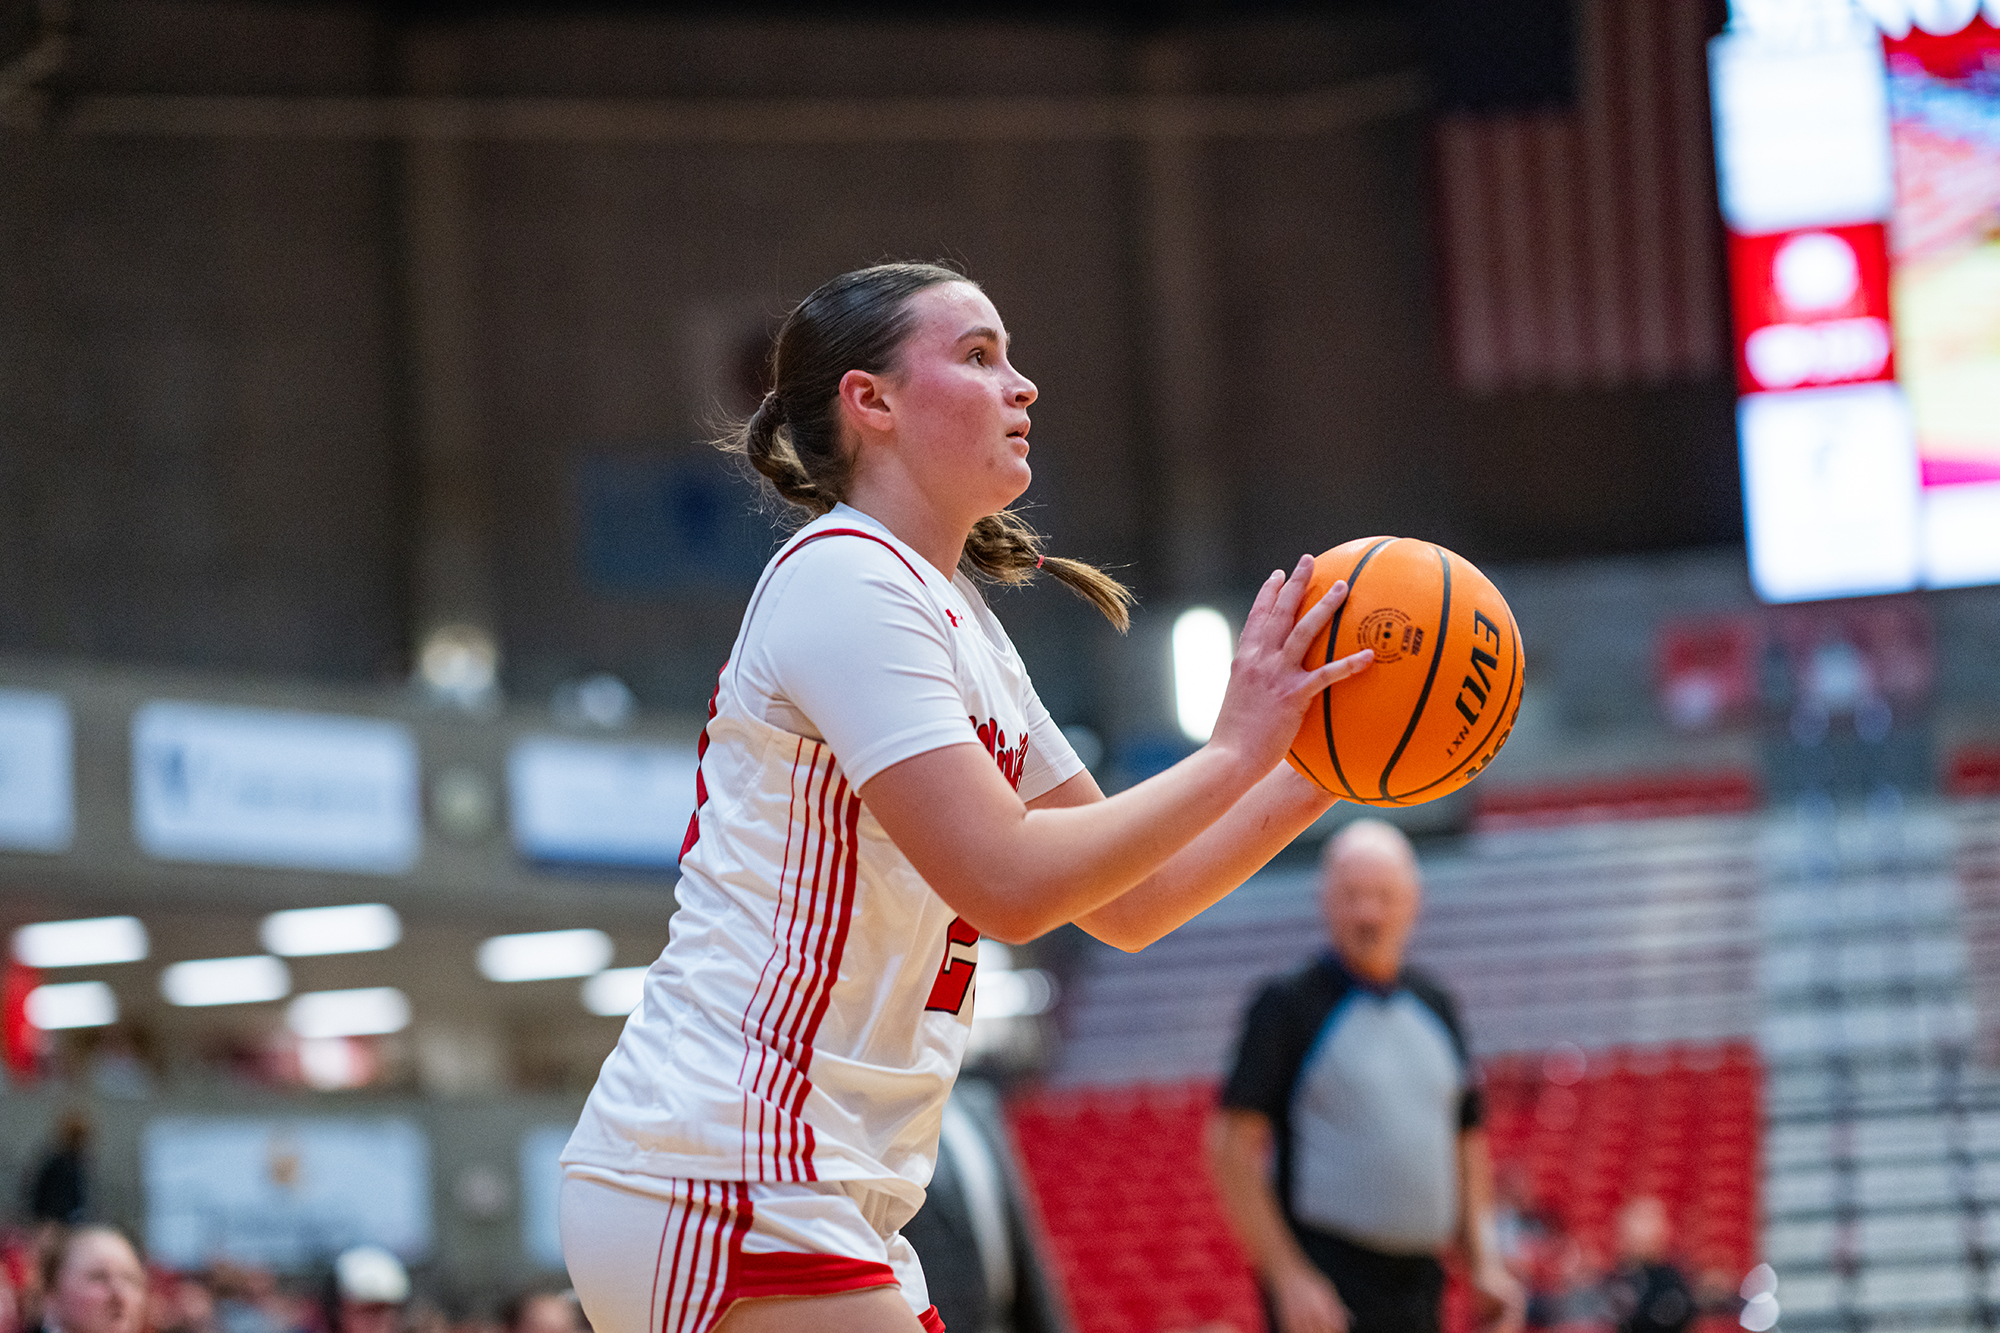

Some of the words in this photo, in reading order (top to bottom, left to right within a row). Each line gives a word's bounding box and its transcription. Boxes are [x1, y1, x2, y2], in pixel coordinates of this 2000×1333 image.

[1455, 609, 1500, 726] EVO
[1446, 725, 1470, 758] NXT
[924, 916, 980, 1016] 2
